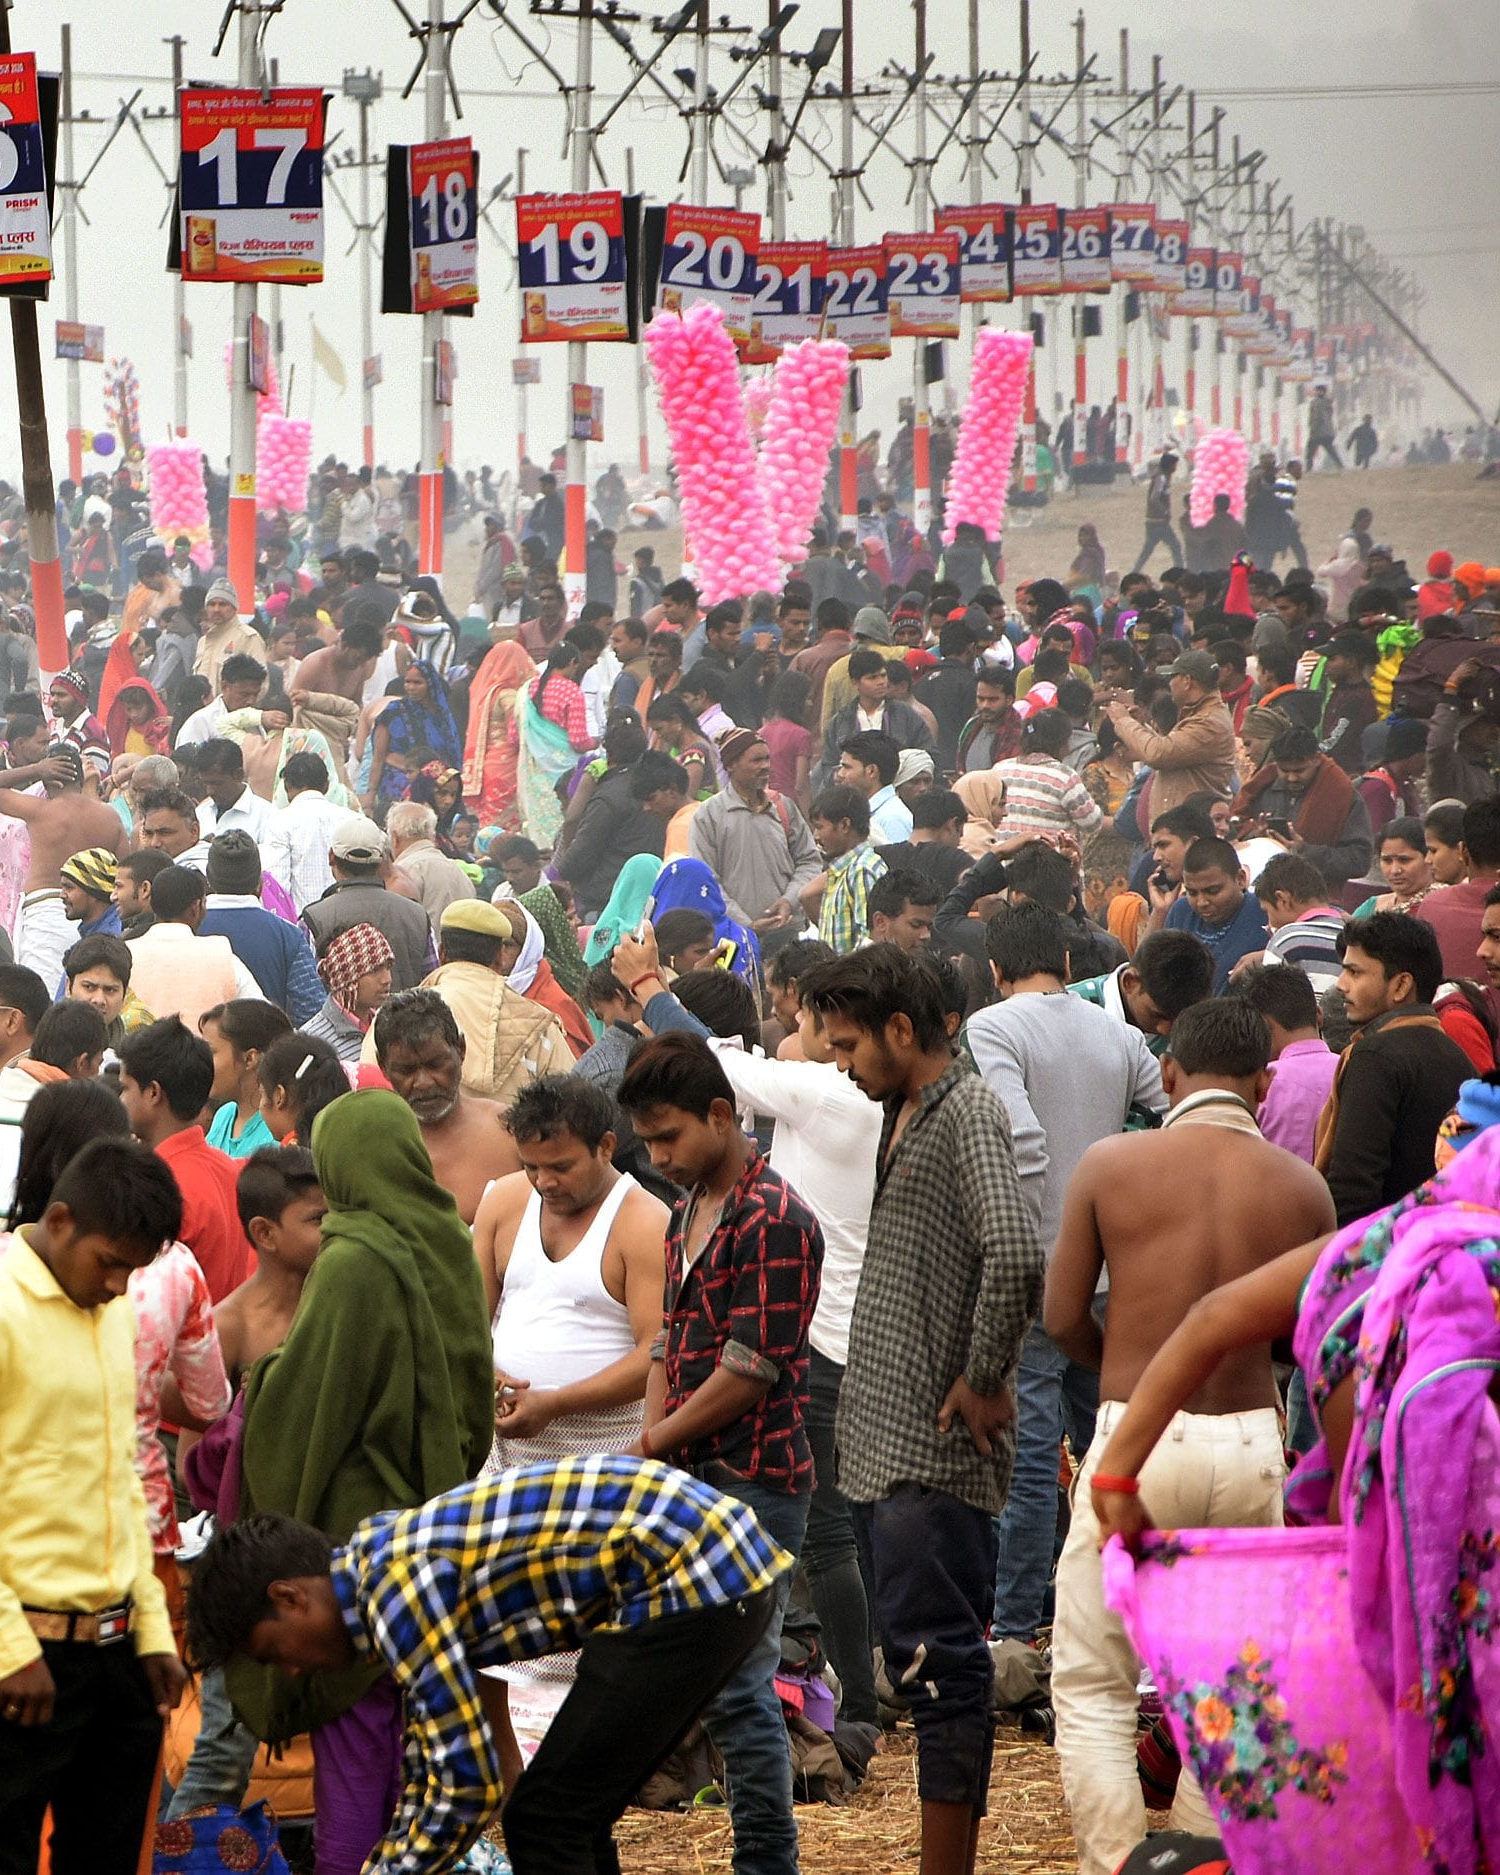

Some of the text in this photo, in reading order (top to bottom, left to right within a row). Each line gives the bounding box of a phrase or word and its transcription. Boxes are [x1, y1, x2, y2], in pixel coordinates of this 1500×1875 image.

[199, 128, 308, 205] 17
[6, 199, 39, 209] PRISM
[420, 171, 469, 242] 18
[530, 220, 609, 283] 19
[668, 230, 745, 289] 20
[1155, 233, 1181, 263] 8
[752, 264, 811, 314] 21
[826, 267, 879, 316] 22
[889, 252, 951, 295] 23
[1187, 260, 1206, 289] 9
[1217, 265, 1236, 291] 0
